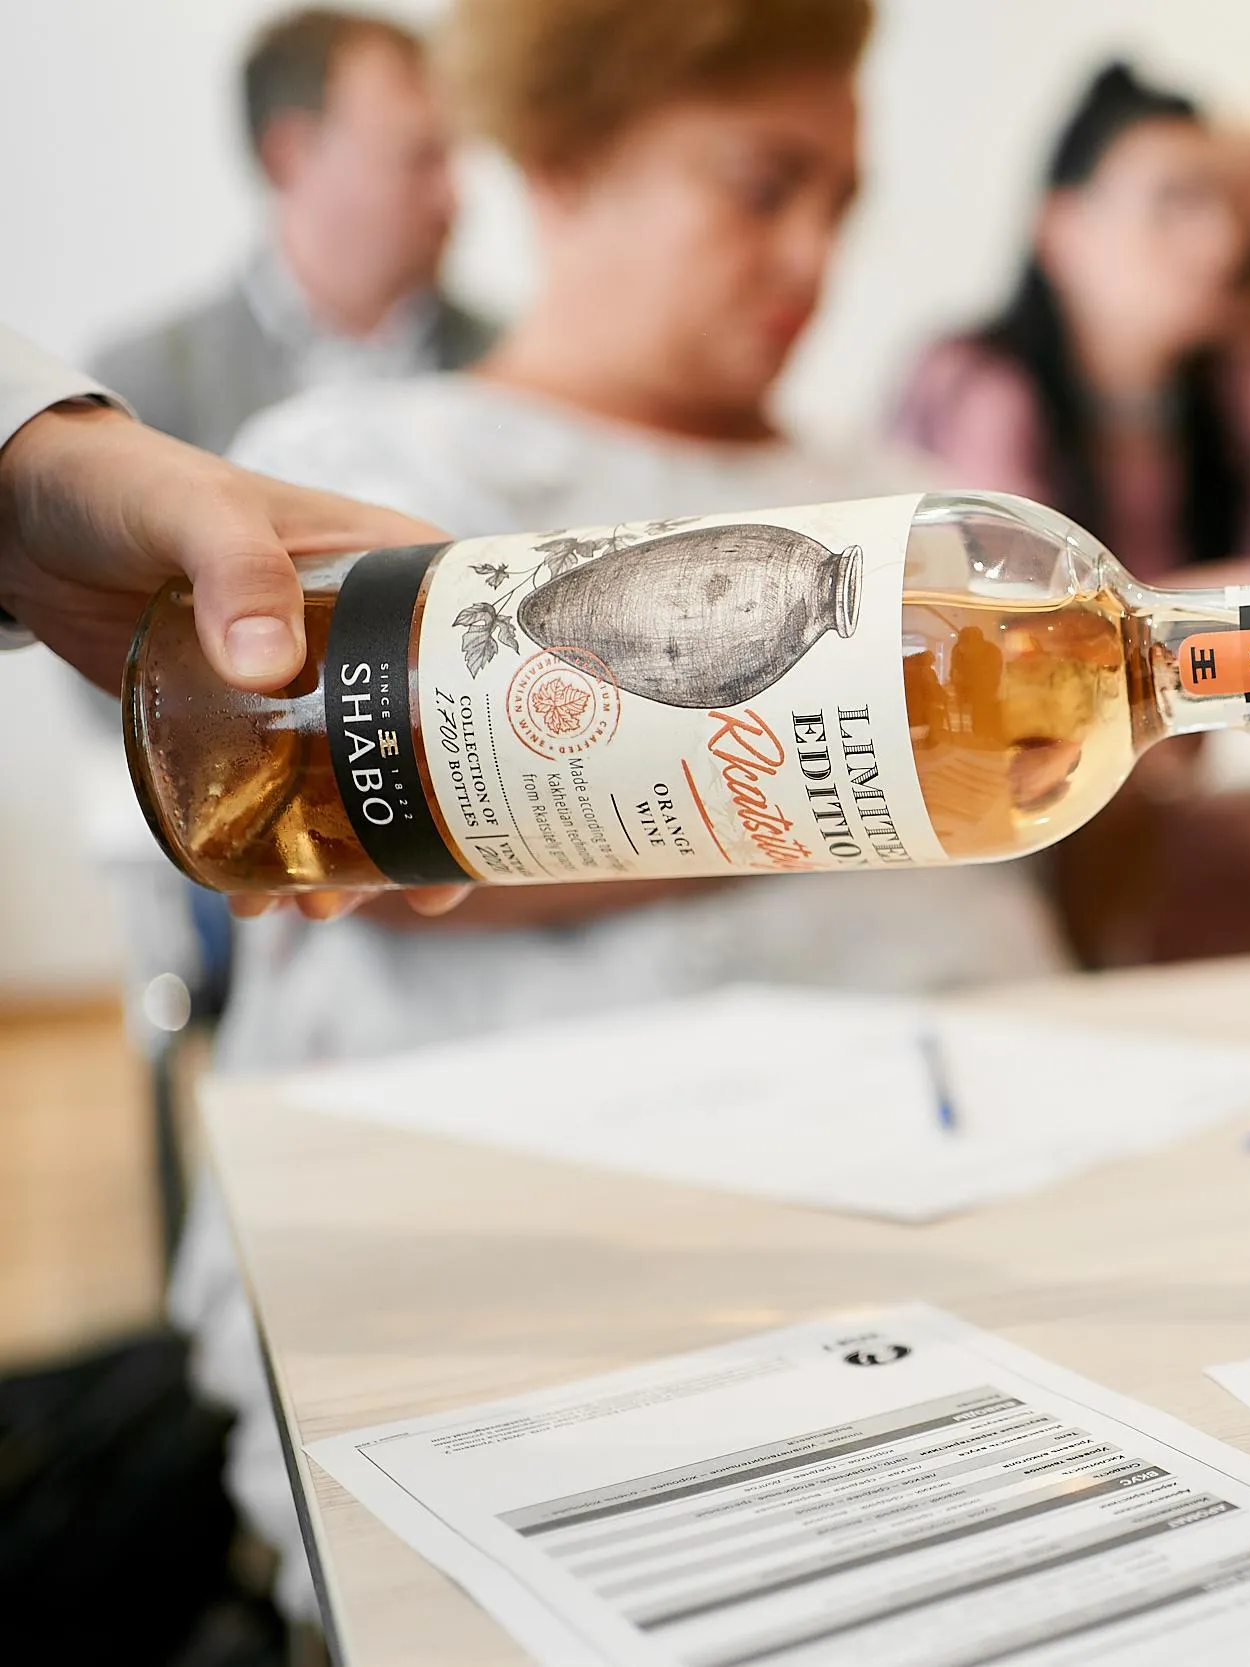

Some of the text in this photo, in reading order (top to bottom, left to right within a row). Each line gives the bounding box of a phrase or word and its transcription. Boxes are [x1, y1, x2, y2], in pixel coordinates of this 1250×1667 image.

[341, 663, 394, 826] SHABO
[380, 663, 413, 820] SINCE 1822
[519, 719, 545, 748] WINE
[559, 721, 607, 754] CRAFTED
[460, 695, 499, 826] COLLECTION OF
[568, 758, 589, 792] Made
[449, 760, 479, 828] BOTTLES
[522, 774, 540, 802] from
[547, 773, 574, 828] Kakhetian
[635, 800, 665, 848] WINE
[653, 782, 695, 856] ORANGE
[1054, 1431, 1079, 1441] Тело
[1093, 1462, 1141, 1479] Сладость
[1119, 1470, 1159, 1486] ВКУС
